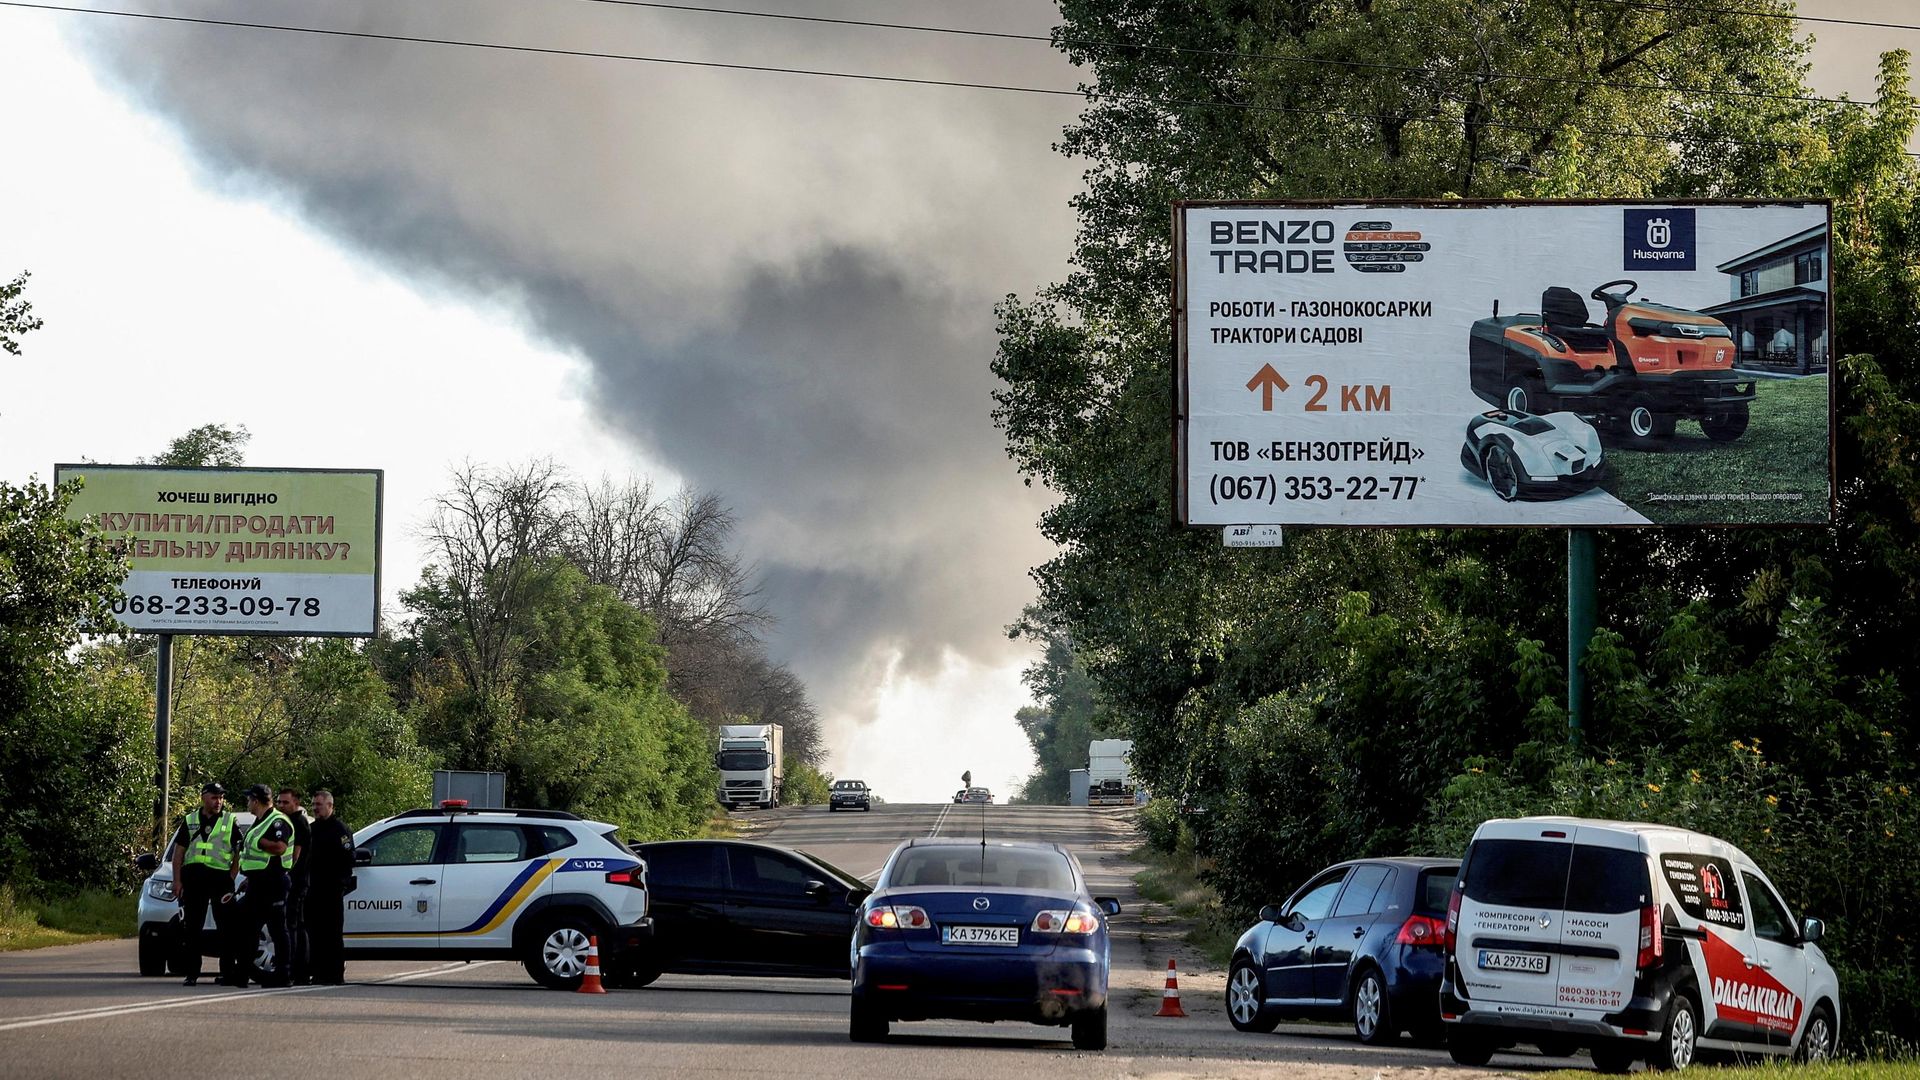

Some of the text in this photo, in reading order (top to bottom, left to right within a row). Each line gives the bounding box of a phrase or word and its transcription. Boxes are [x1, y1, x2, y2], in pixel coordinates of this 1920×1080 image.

[1210, 220, 1335, 245] BENZO
[1210, 250, 1335, 274] TRADE
[1633, 249, 1685, 261] Husqvarna
[1210, 301, 1275, 318] РОБОТИ
[1291, 301, 1432, 317] ГАЗОНОКОСАРКИ
[1210, 327, 1363, 346] ТРАКТОРИ САДОВІ
[1304, 374, 1328, 412] 2
[1211, 437, 1425, 465] ТОВ «БЕНЗОТРЕЙД»
[1210, 474, 1277, 505] (067)
[157, 491, 278, 506] ХОЧЕШ ВИГІДНО
[101, 512, 335, 538] КУПИТИ/ПРОДАТИ
[225, 540, 351, 563] ДІЛЯНКУ?
[171, 577, 261, 590] ТЕЛЕФОНУЙ
[111, 595, 321, 617] 068-233-09-78
[584, 860, 604, 869] 102
[348, 900, 402, 911] ПОЛІЦІЯ
[1479, 911, 1535, 922] КОМПРЕСОРИ
[1706, 908, 1743, 924] 0800-30-13-77
[1477, 922, 1530, 933] ГЕНЕРАТОРИ
[1571, 919, 1609, 929] НАСОСИ
[950, 928, 1017, 941] KA 3796 KE
[1570, 929, 1602, 939] ХОЛОД
[1485, 953, 1544, 970] KA 2973 KB
[1559, 986, 1622, 998] 0800-30-13-77
[1713, 977, 1797, 1020] DALGAKIRAN
[1559, 994, 1621, 1007] 044-206-10-81
[1504, 1005, 1567, 1017] www.dalgakiran.ua
